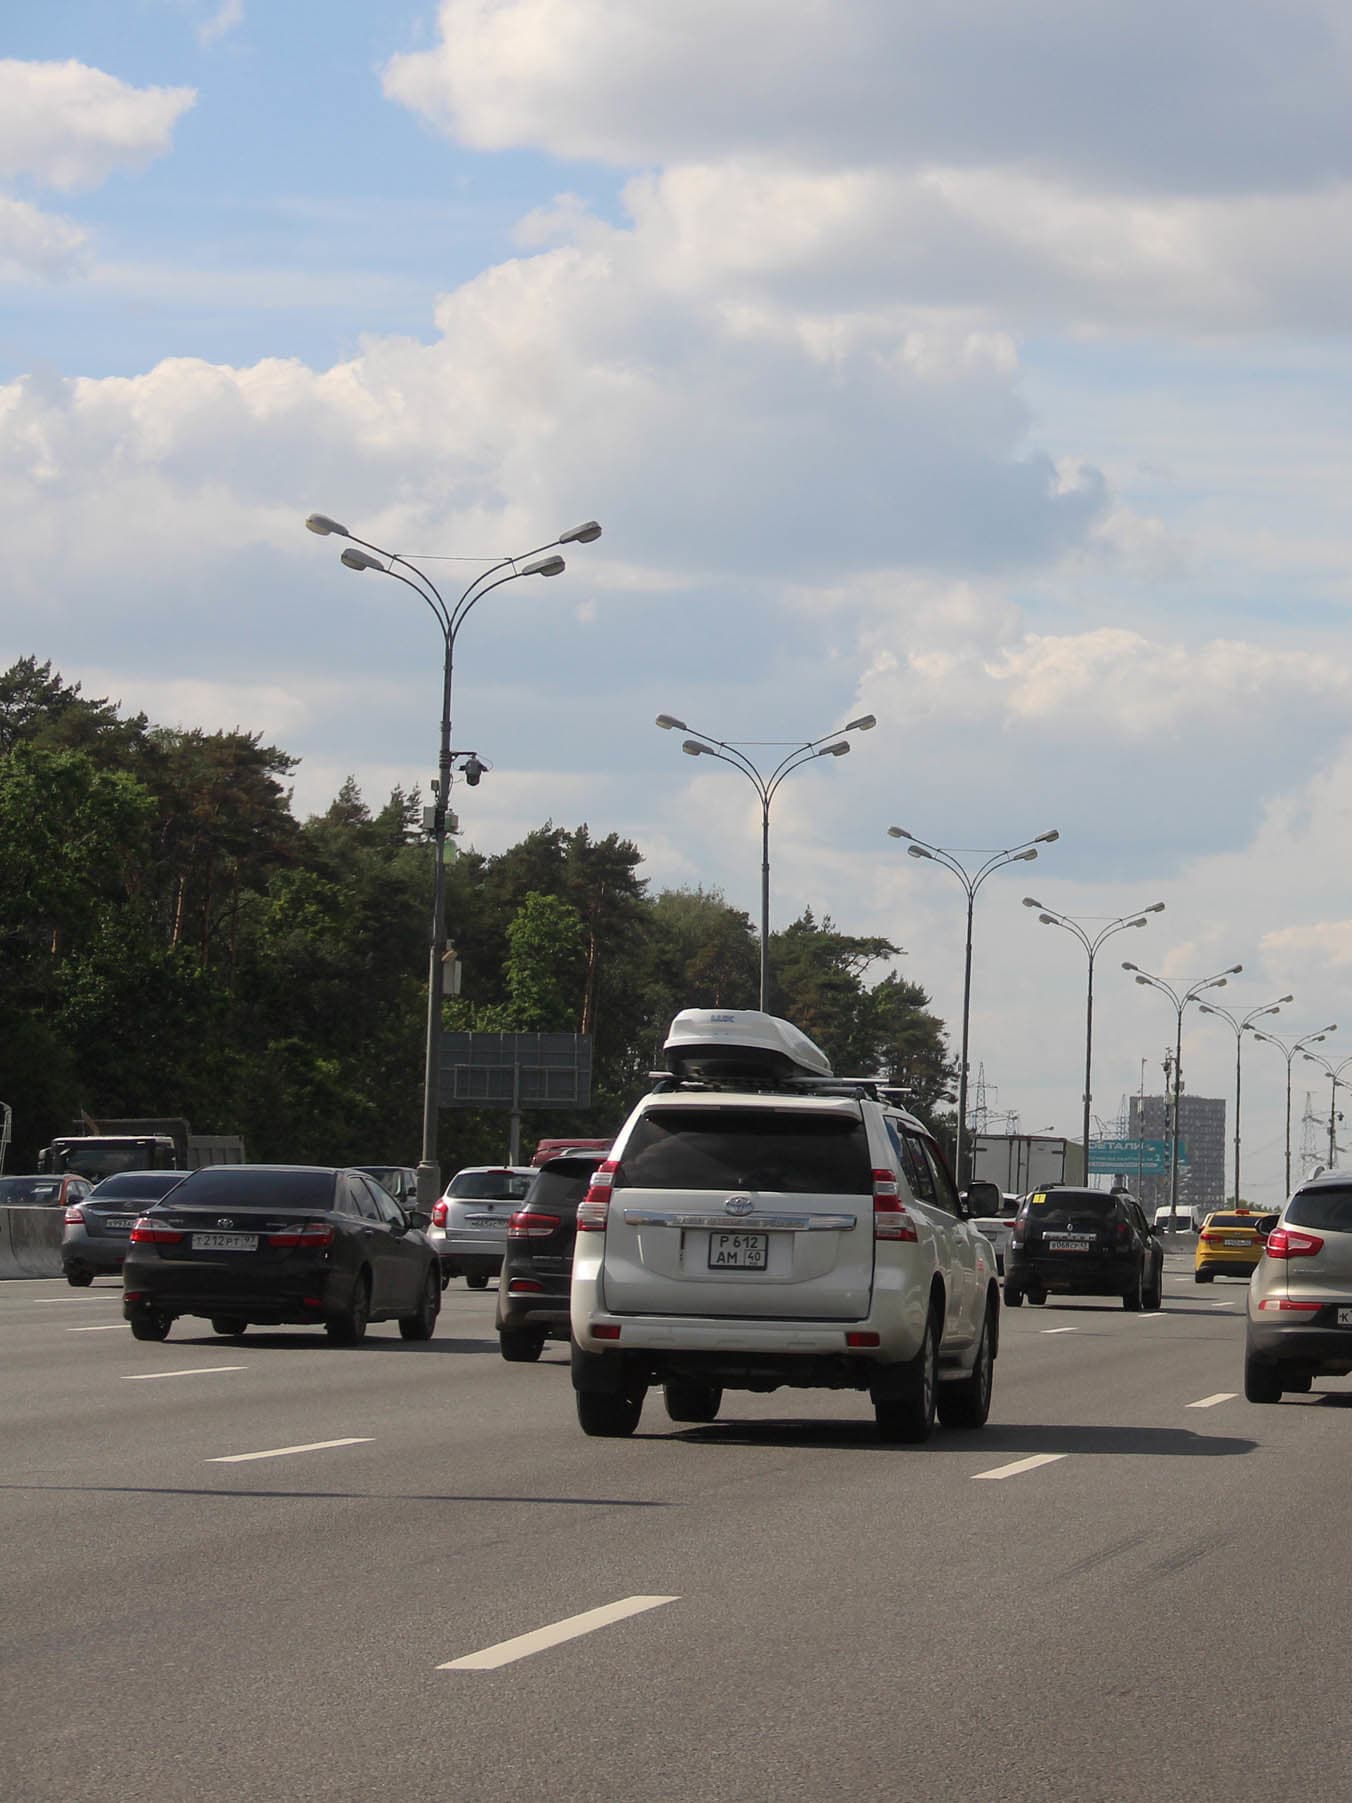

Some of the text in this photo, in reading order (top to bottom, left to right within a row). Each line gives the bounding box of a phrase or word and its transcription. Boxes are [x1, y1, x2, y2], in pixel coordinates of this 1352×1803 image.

[732, 1235, 758, 1249] 612
[716, 1251, 761, 1265] АМ 40
